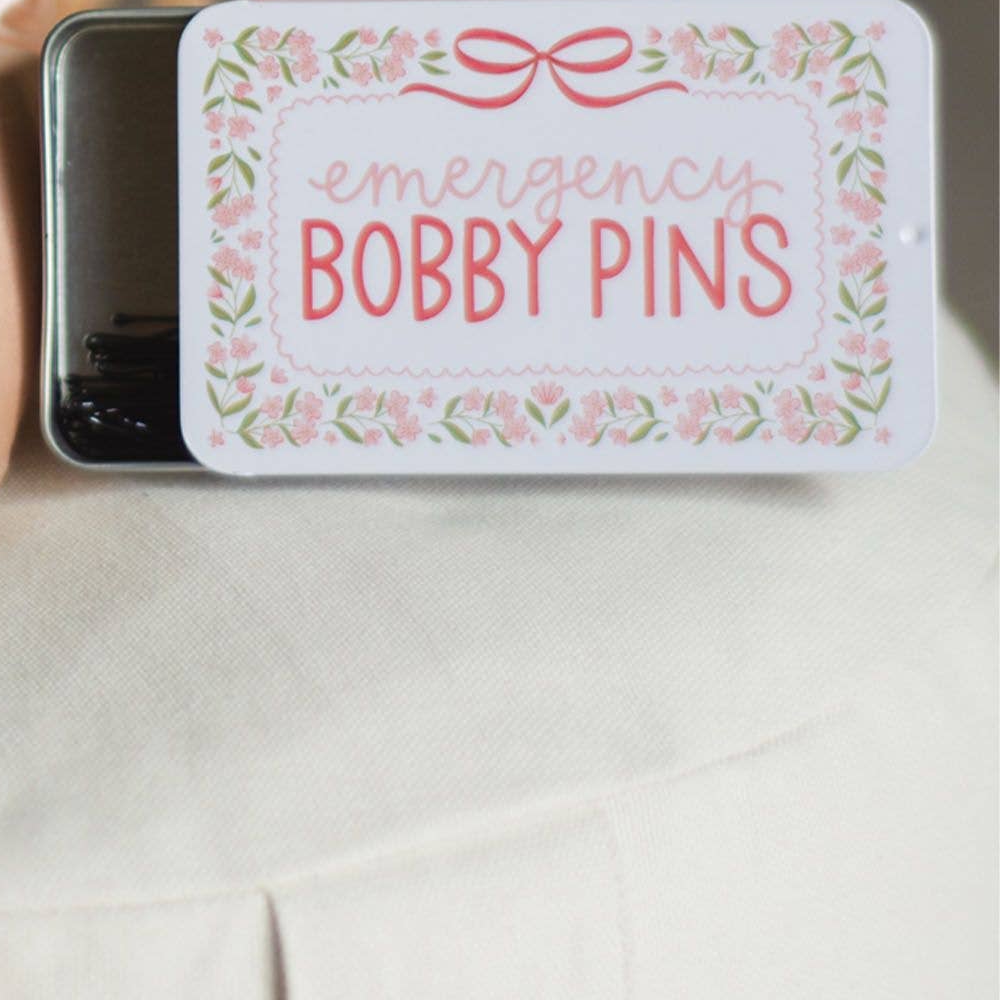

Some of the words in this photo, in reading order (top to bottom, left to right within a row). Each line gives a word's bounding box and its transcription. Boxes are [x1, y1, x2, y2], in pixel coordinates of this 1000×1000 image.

[308, 154, 784, 227] emergency
[300, 213, 564, 324] BOBBY
[590, 212, 793, 320] PINS
